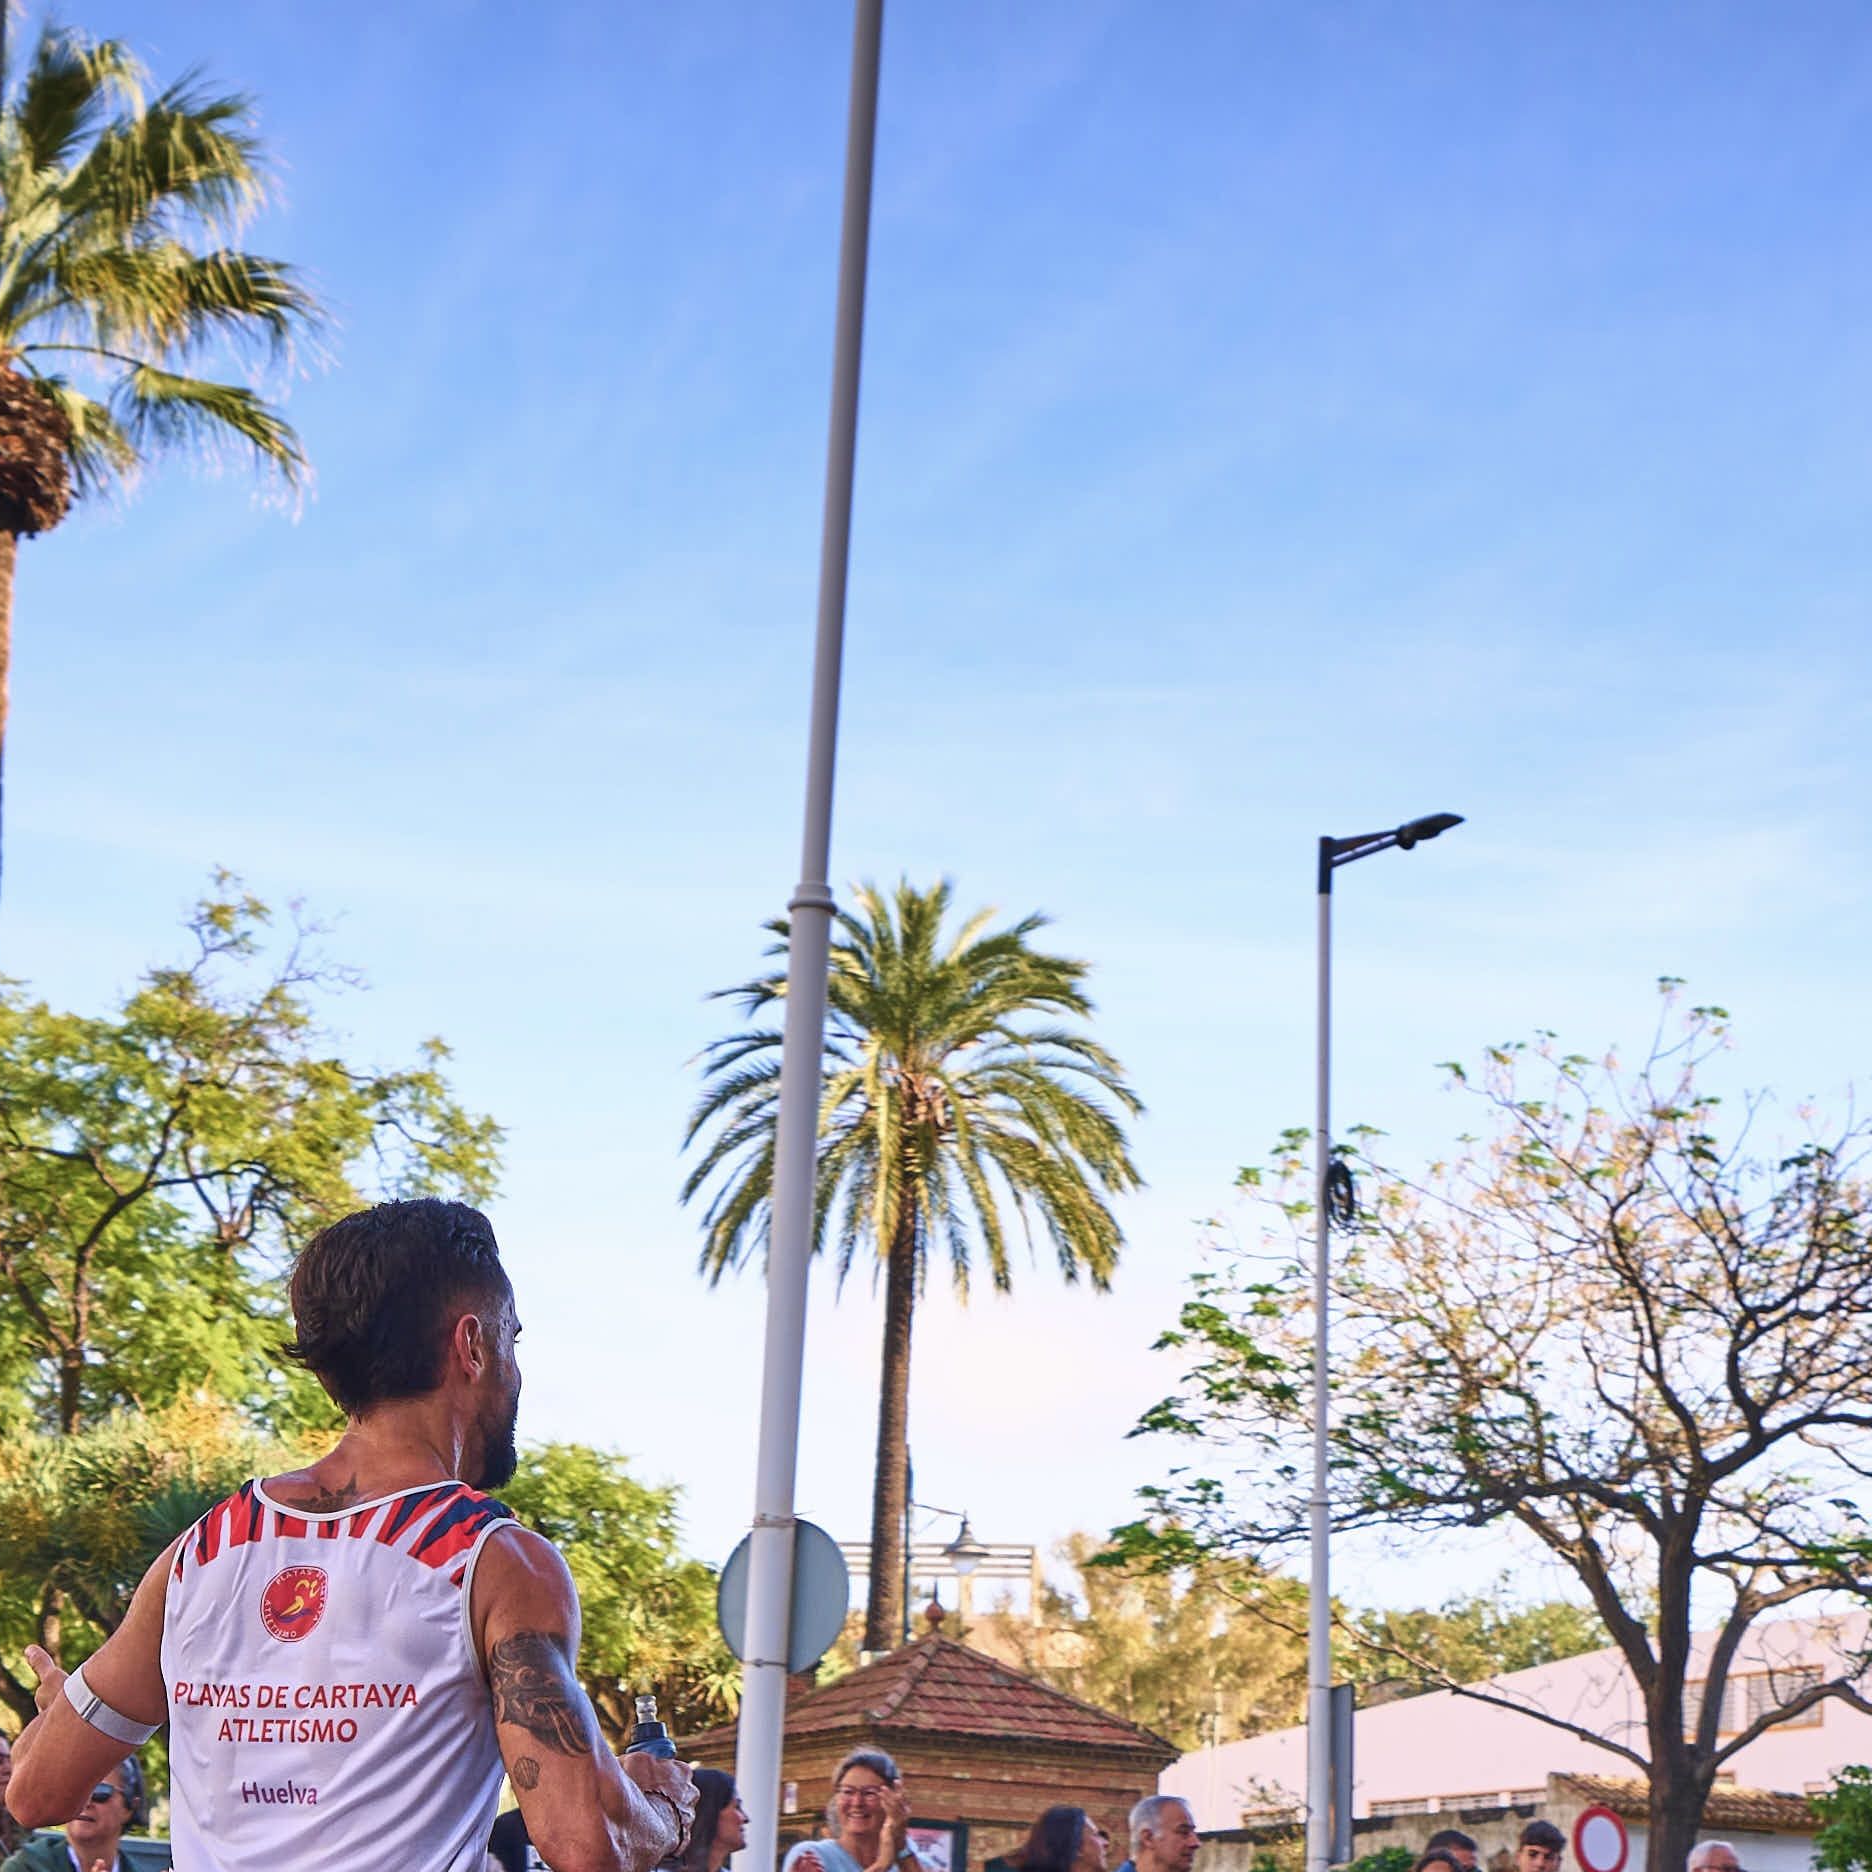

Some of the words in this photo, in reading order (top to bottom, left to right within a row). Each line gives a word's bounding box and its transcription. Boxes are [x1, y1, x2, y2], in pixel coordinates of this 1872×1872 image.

[174, 1682, 251, 1708] PLAYAS
[256, 1685, 289, 1709] DE
[293, 1683, 418, 1709] CARTAYA
[218, 1718, 357, 1743] ATLETISMO
[241, 1780, 318, 1805] Huelva
